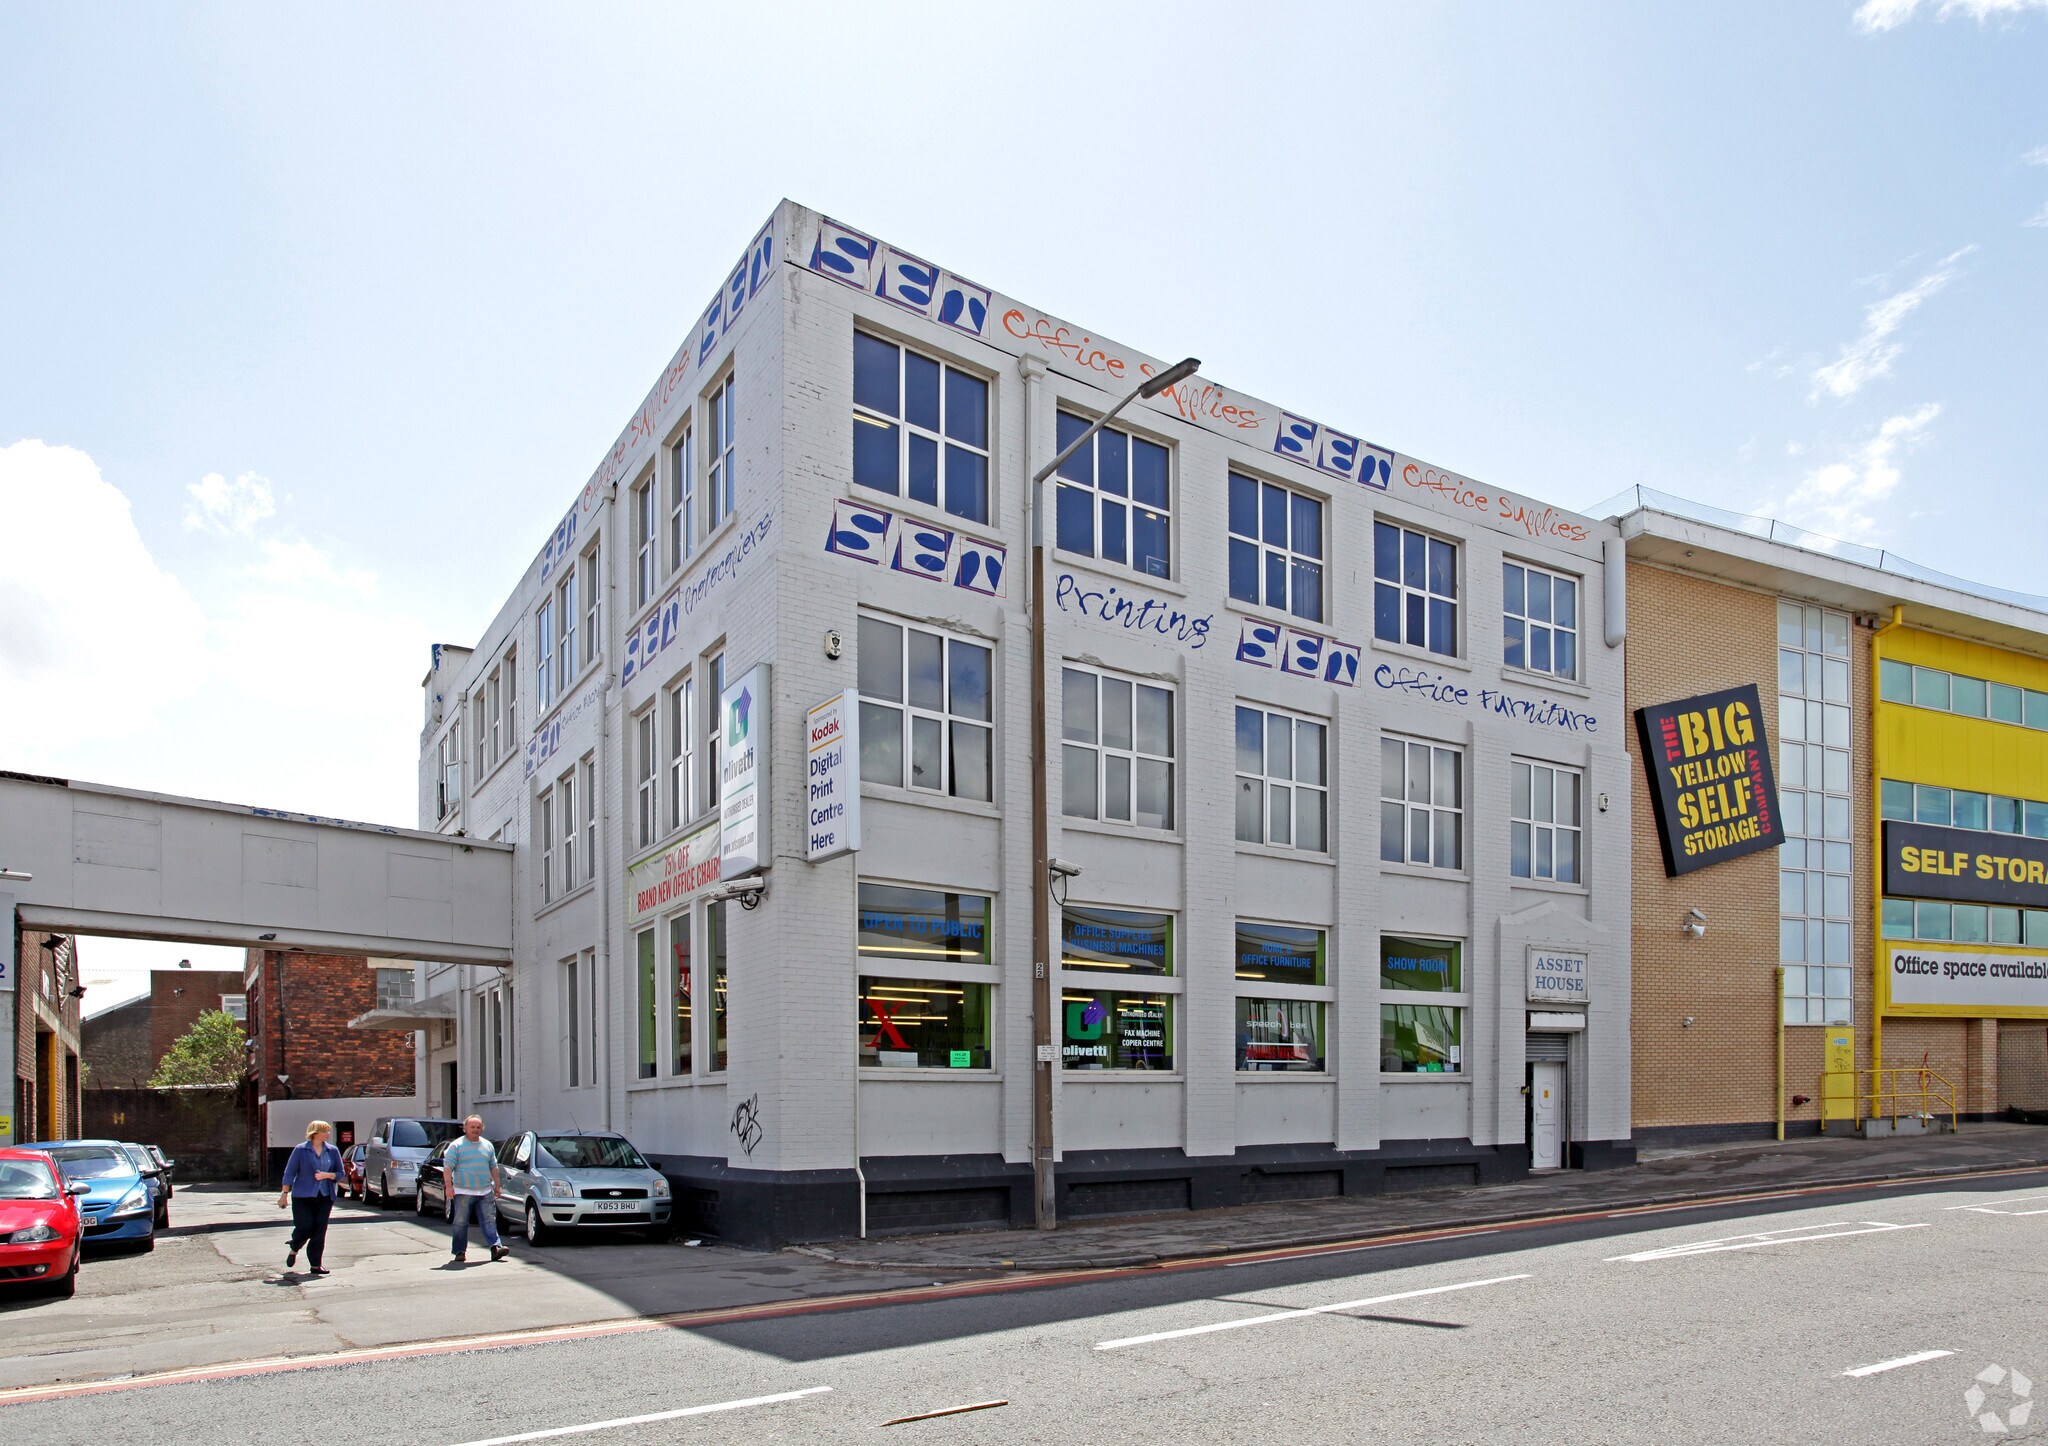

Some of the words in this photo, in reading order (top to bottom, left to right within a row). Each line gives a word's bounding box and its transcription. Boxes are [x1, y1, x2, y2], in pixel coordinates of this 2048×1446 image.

[1002, 308, 1125, 379] Office
[1140, 363, 1266, 428] Supplies
[1402, 463, 1488, 513] Office
[1499, 496, 1592, 542] Supplies
[684, 507, 776, 616] Photocopiers
[1055, 574, 1213, 649] Printing
[1374, 663, 1469, 706] Office
[1478, 689, 1598, 733] Furniture
[811, 717, 840, 743] Kodak
[1660, 716, 1681, 762] THE
[1677, 701, 1756, 758] BIG
[724, 746, 754, 784] olivetti
[810, 746, 842, 777] Digital
[1669, 750, 1746, 789] YELLOW
[810, 777, 834, 802] Print
[1677, 776, 1752, 829] SELF
[1747, 748, 1772, 834] COMPANY
[810, 802, 844, 826] Centre
[811, 831, 835, 852] Here
[1683, 815, 1761, 856] STORAGE
[677, 844, 690, 871] OFF
[1901, 846, 1969, 876] SELF
[1975, 854, 2048, 885] STOR
[637, 886, 657, 913] BRAND
[658, 878, 673, 905] NEW
[673, 867, 695, 898] OFFICE
[863, 911, 904, 932] OPEN
[907, 915, 927, 935] TO
[931, 918, 981, 939] PUBLIC
[1074, 924, 1107, 938] OFFICE
[1109, 927, 1152, 942] SUPPLIES
[1071, 938, 1117, 953] BUSINESS
[1118, 942, 1165, 956] MACHINES
[1241, 953, 1268, 966] OFFICE
[1270, 956, 1311, 968] FURNITURE
[1261, 943, 1284, 954] HOME
[1387, 956, 1417, 970] SHOW
[1419, 959, 1448, 973] ROOM
[1535, 957, 1583, 973] ASSET
[1895, 955, 1939, 975] Office
[1943, 961, 1987, 980] space
[1990, 960, 2048, 980] availabl
[1535, 975, 1583, 992] HOUSE
[1124, 1029, 1136, 1037] FAX
[1136, 1029, 1160, 1037] MACHINE
[1246, 1020, 1282, 1029] speech
[1062, 1045, 1107, 1057] olivetti
[1121, 1039, 1142, 1047] COPIER
[1142, 1039, 1164, 1047] CENTRE
